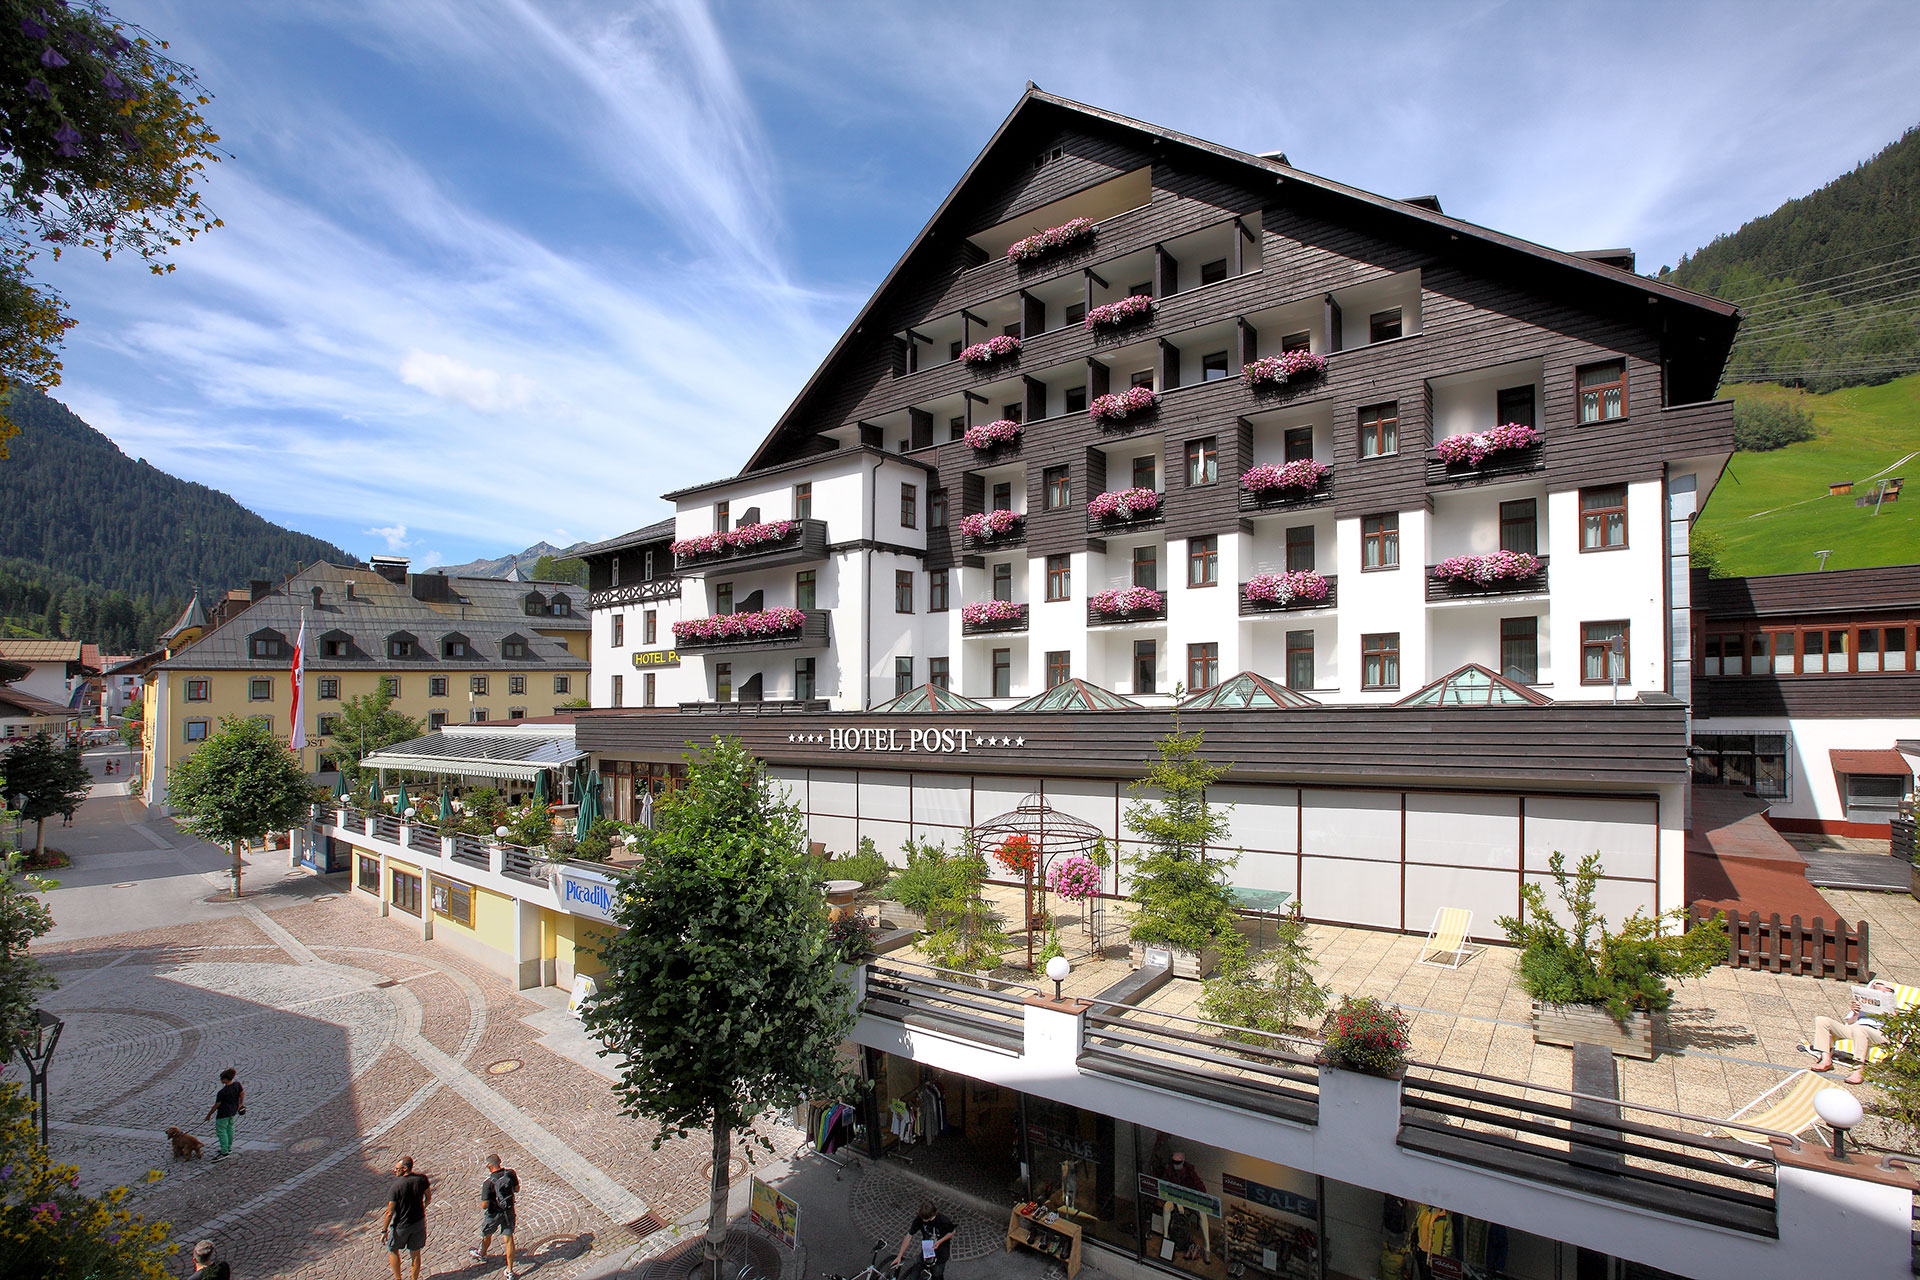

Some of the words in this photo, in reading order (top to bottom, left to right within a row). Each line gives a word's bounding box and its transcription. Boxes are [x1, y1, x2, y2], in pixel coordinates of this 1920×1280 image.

[635, 652, 666, 664] HOTEL
[828, 728, 904, 751] HOTEL
[909, 728, 972, 752] POST
[566, 880, 613, 915] Piccadilly
[1053, 1135, 1093, 1158] SALE
[1255, 1187, 1309, 1215] SALE
